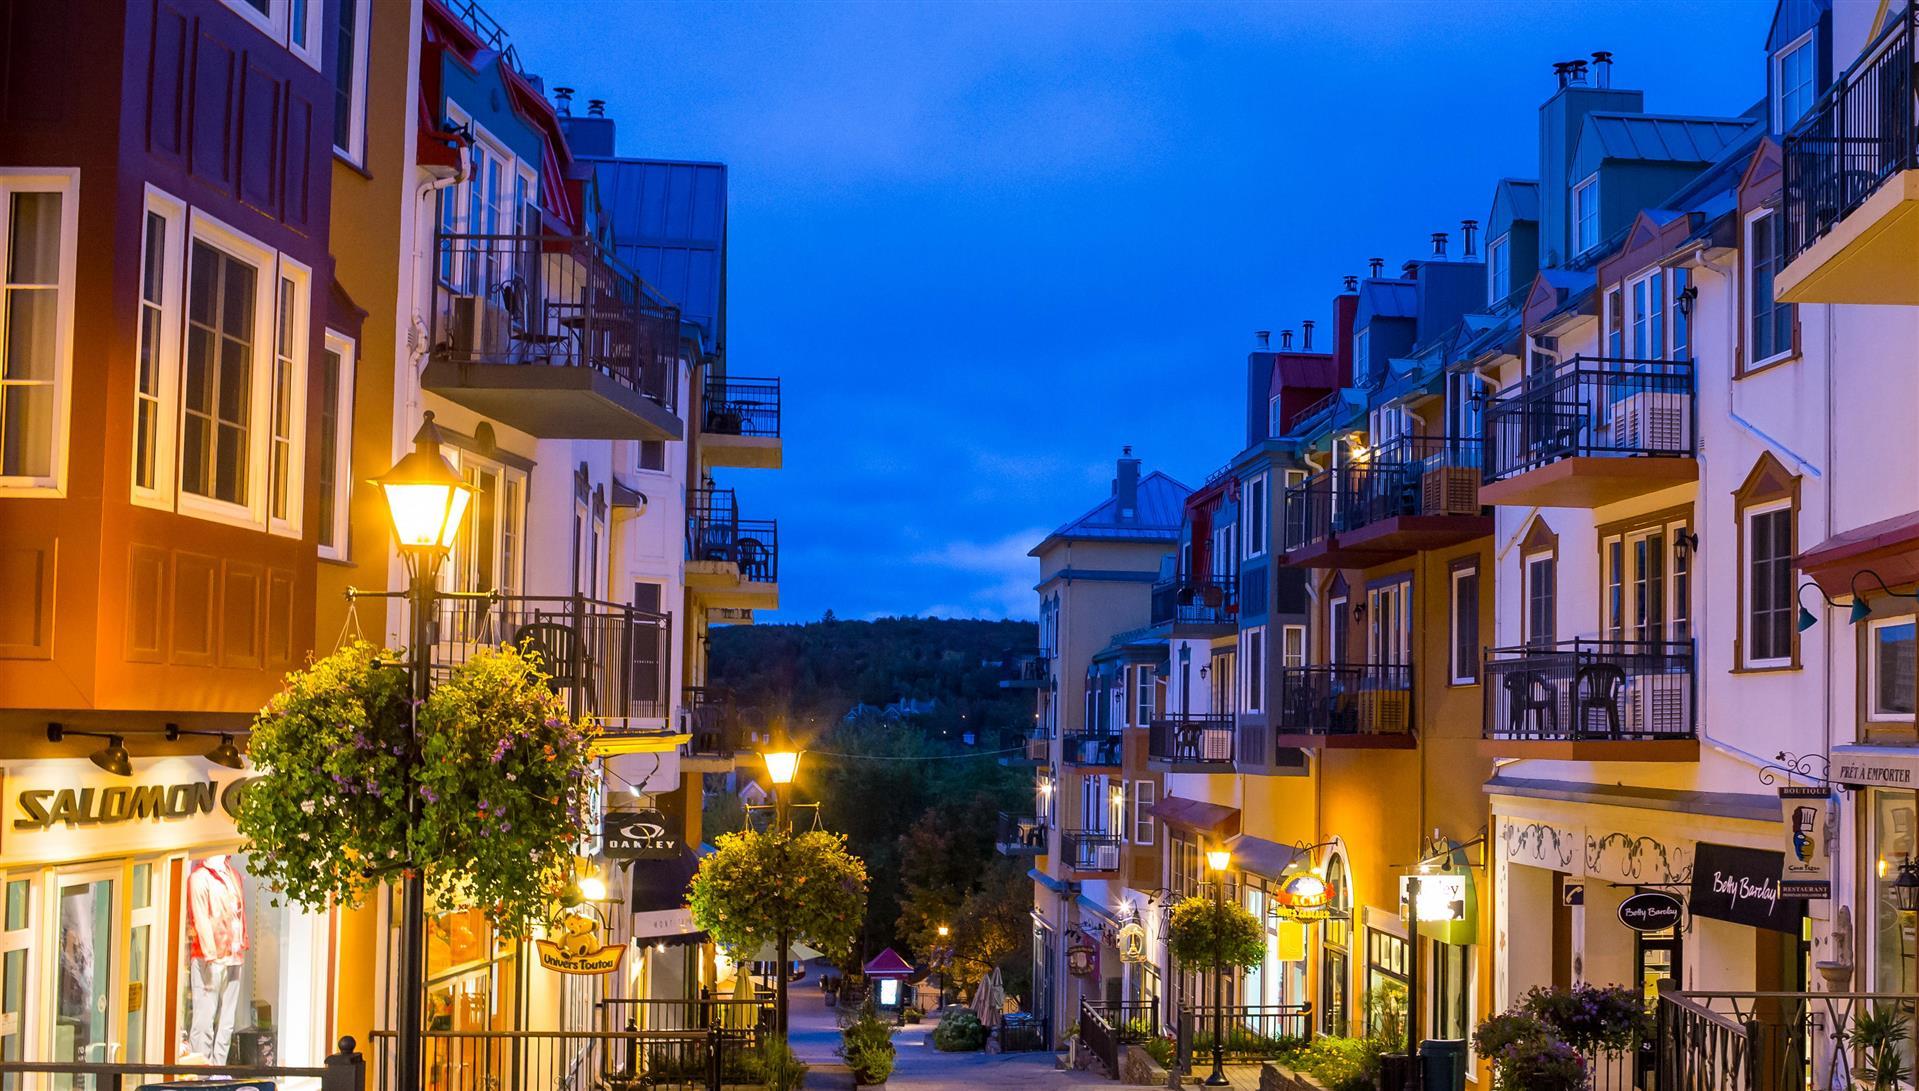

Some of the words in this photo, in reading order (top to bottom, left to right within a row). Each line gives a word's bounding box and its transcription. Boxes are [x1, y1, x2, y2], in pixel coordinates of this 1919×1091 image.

[1840, 762, 1859, 779] PRÊT
[1867, 767, 1911, 783] EMPORTER
[1783, 787, 1827, 795] BOUTIQUE
[13, 780, 219, 831] SALOMON
[1290, 893, 1328, 907] ACME
[1712, 870, 1739, 910] Betty
[1739, 876, 1778, 917] Barclay
[1625, 907, 1647, 921] Betty
[1647, 906, 1678, 919] Barclay
[543, 953, 579, 970] Univers
[579, 957, 614, 970] Toutou
